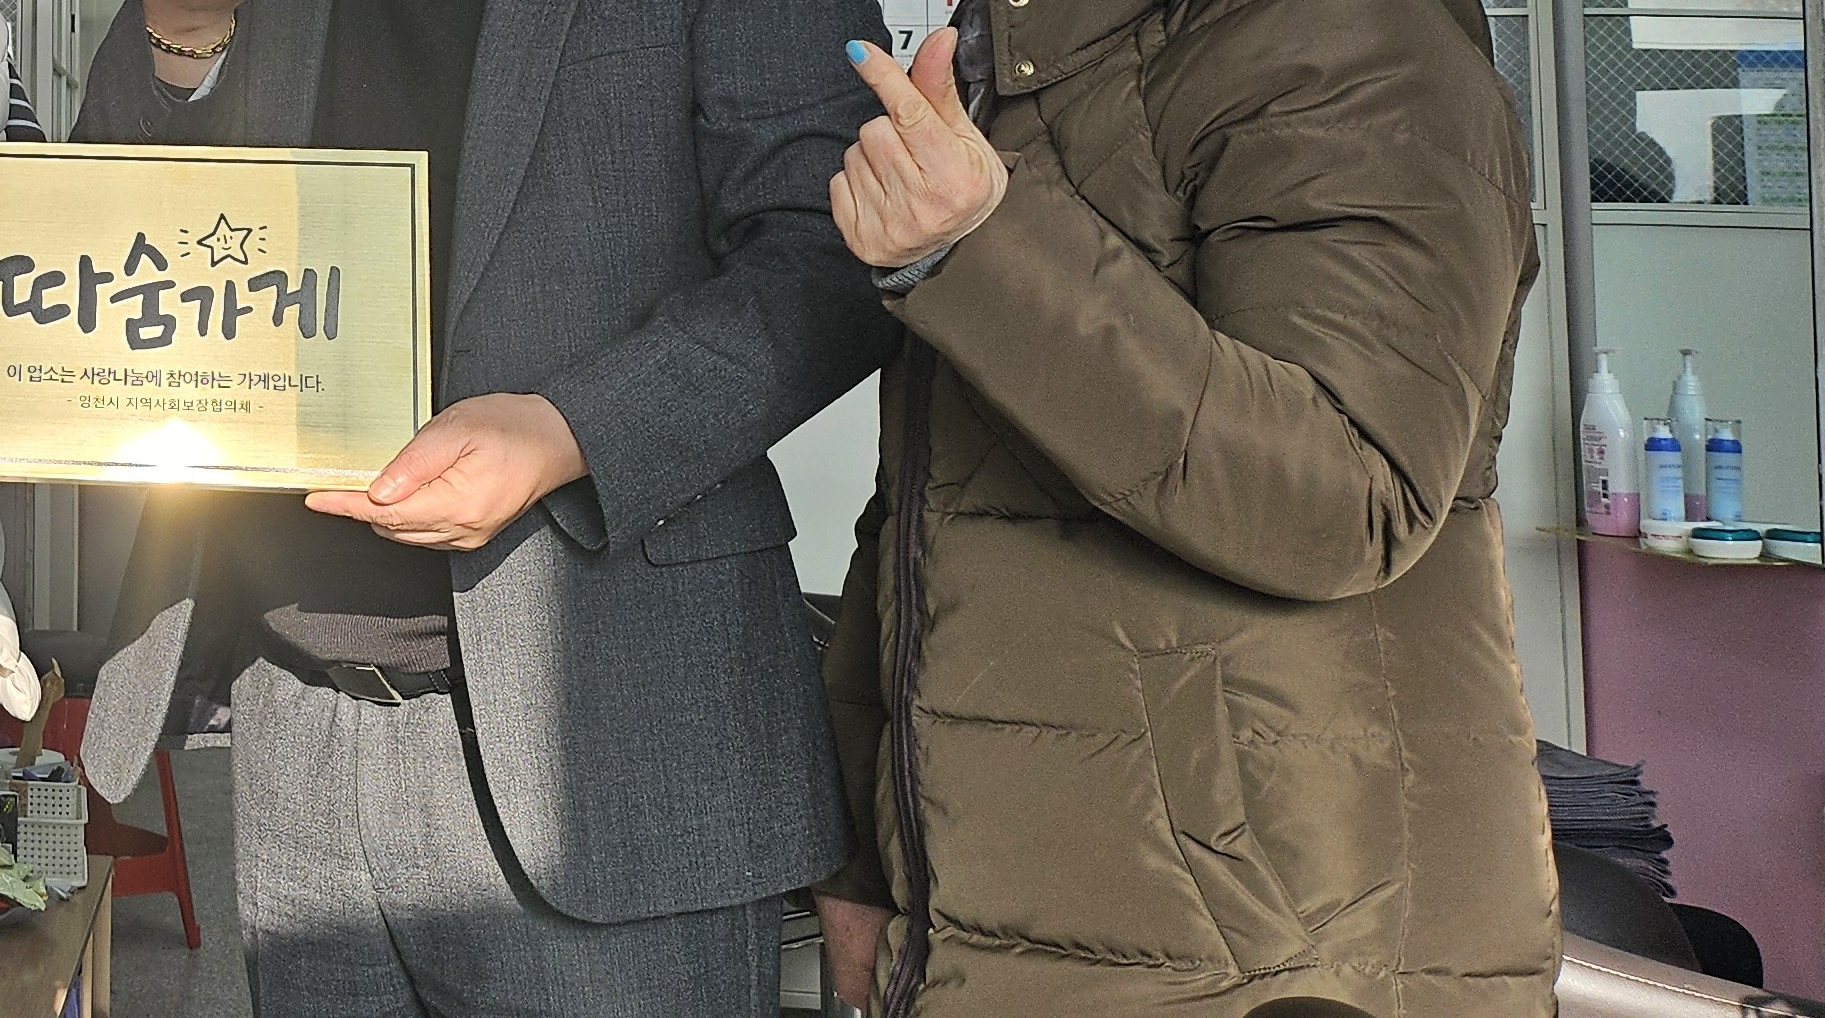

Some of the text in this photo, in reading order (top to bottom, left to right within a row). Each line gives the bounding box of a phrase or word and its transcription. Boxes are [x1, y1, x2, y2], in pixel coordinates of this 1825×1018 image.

[898, 29, 914, 51] 7
[7, 363, 326, 393] 이 업소는 사랑나눔에 참여하는 가게입니다.
[125, 396, 251, 414] 지역사회보장협의체
